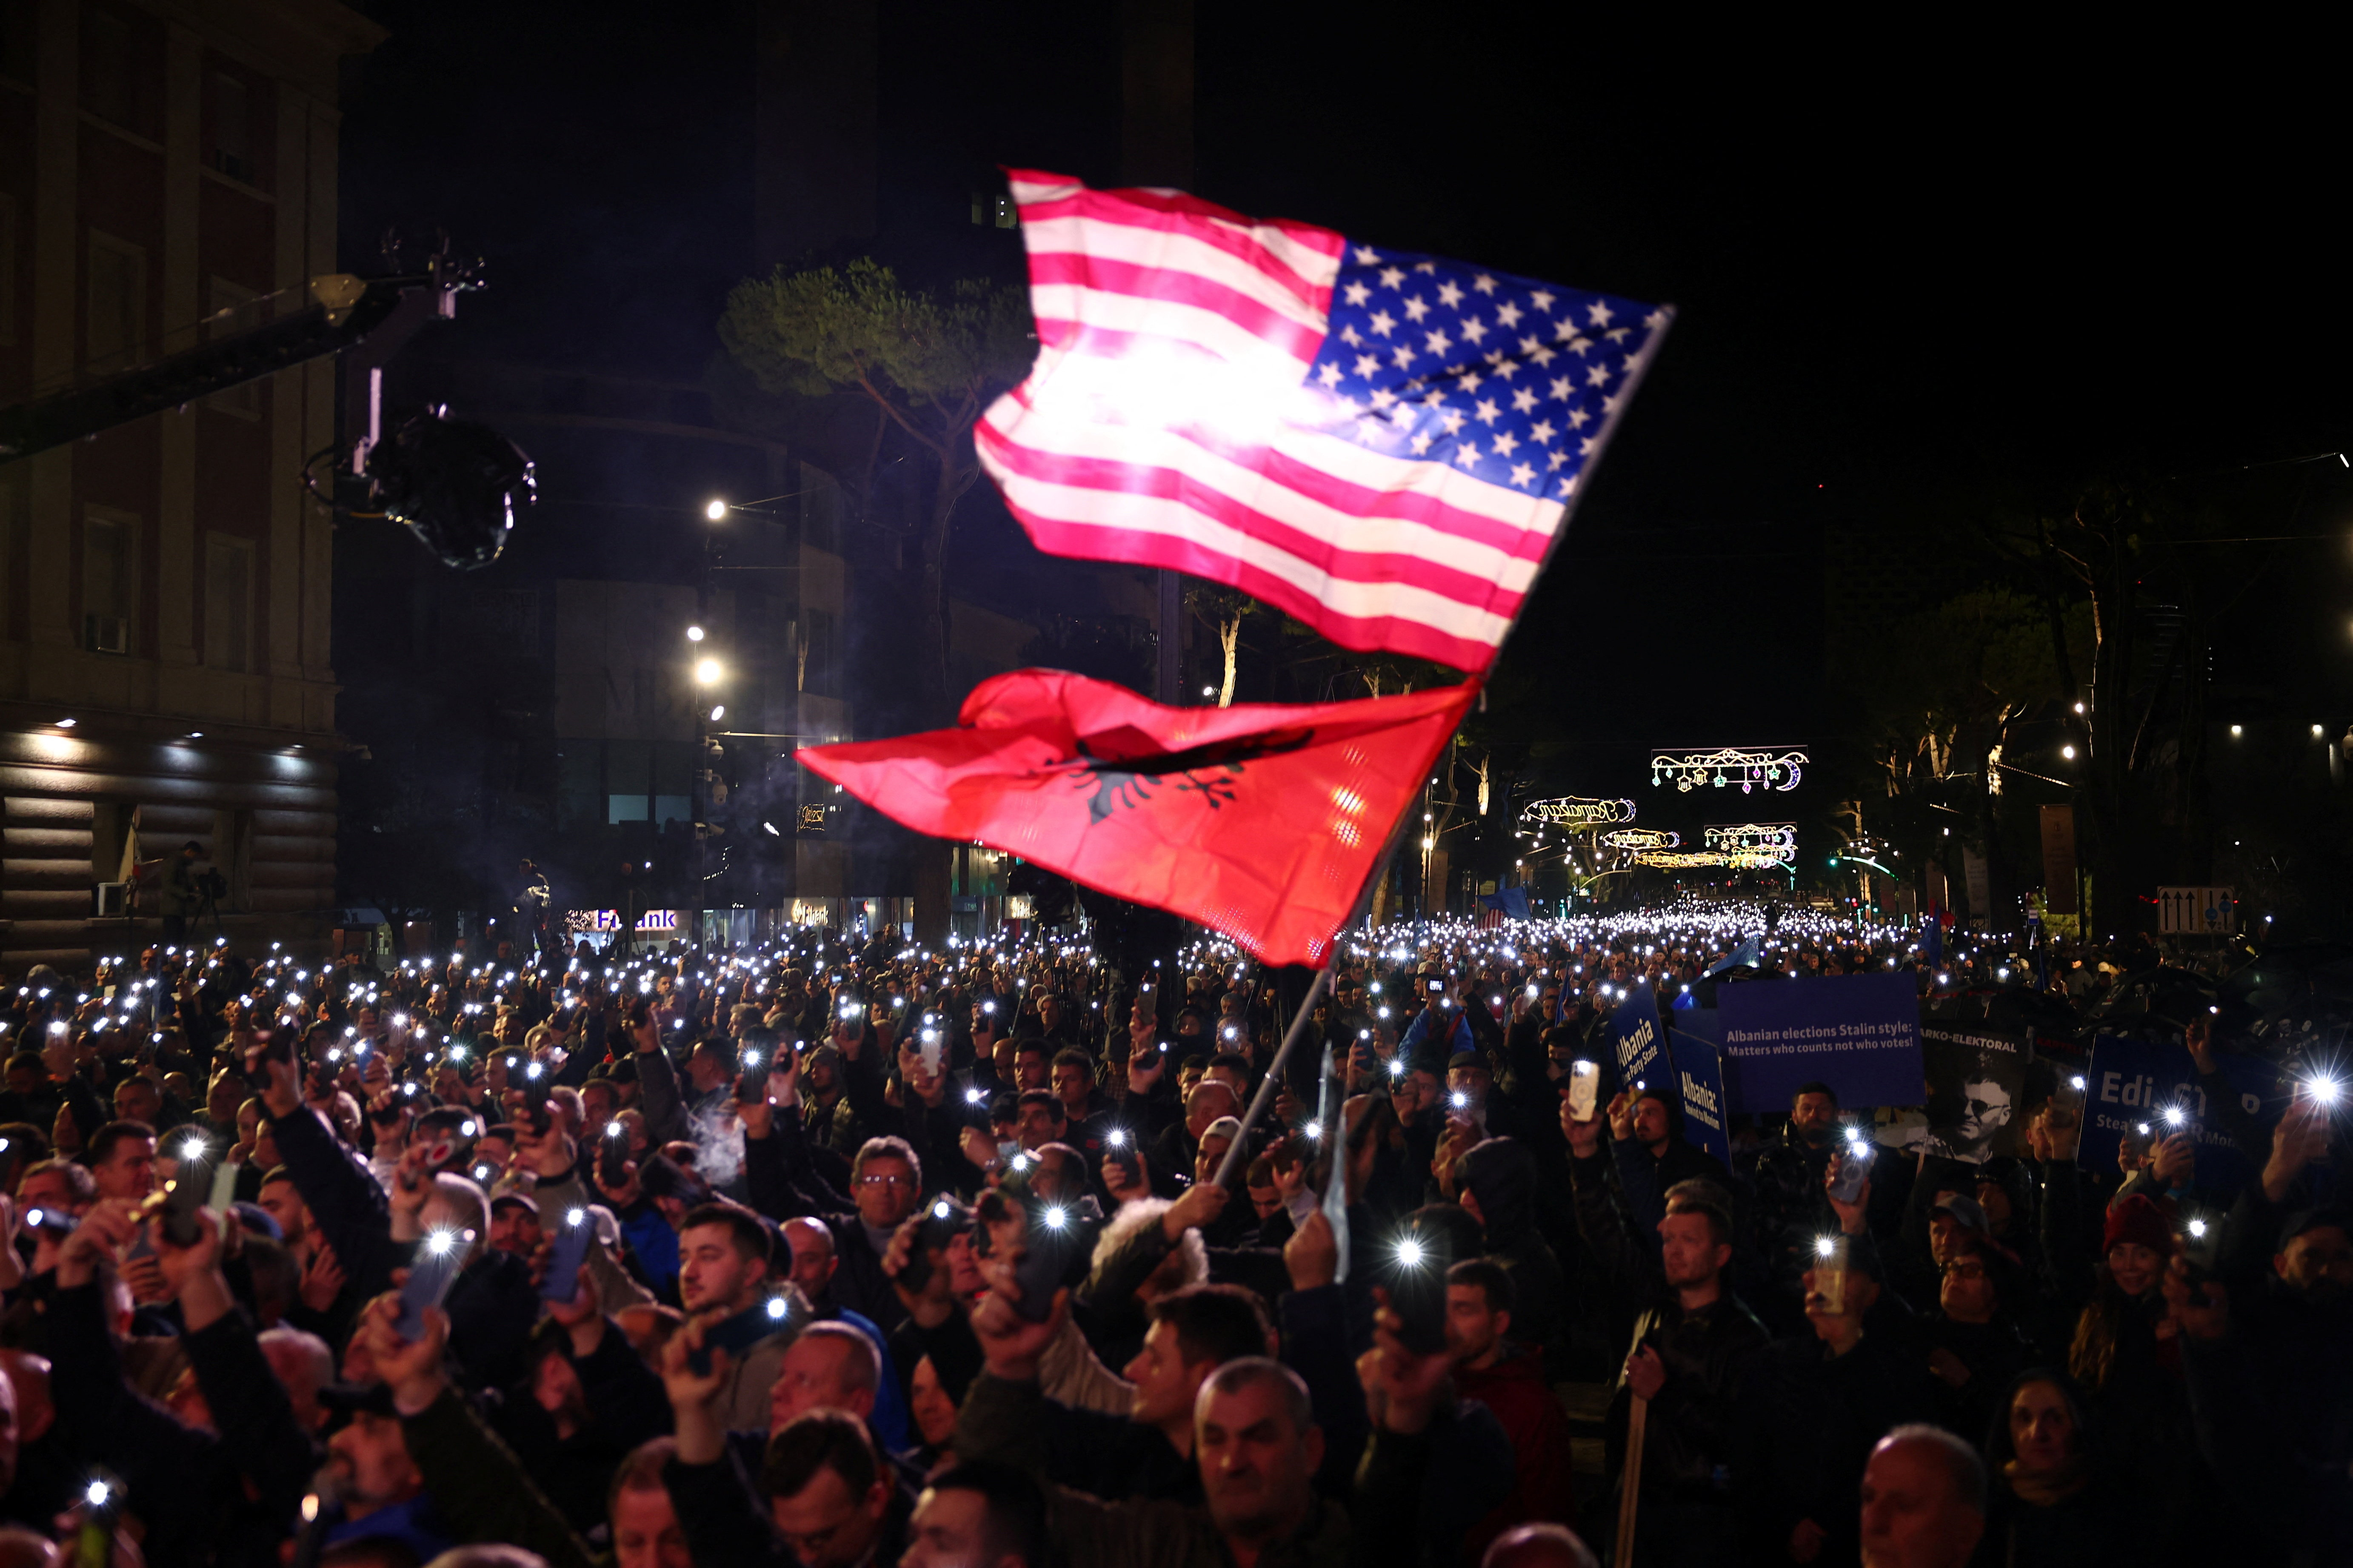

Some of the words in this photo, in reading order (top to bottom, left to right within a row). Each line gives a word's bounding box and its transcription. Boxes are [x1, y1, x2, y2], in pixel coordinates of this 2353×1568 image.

[598, 909, 675, 927] Fiank
[1616, 1018, 1654, 1071] Albania
[1727, 1028, 1779, 1043] Albanian
[1782, 1026, 1837, 1039] elections
[1839, 1023, 1876, 1036] Stalin
[1879, 1021, 1913, 1036] style:
[1728, 1046, 1770, 1056] Matters
[1773, 1043, 1795, 1054] who
[1797, 1042, 1833, 1053] counts
[1835, 1041, 1853, 1051] not
[1856, 1039, 1878, 1049] who
[1880, 1037, 1913, 1048] votes!
[1920, 1028, 2018, 1053] ARKO-ELEKTORAL
[1629, 1058, 1644, 1078] Party
[1642, 1045, 1658, 1066] State
[1682, 1071, 1718, 1114] Albania:
[2173, 1083, 2260, 1117] STP
